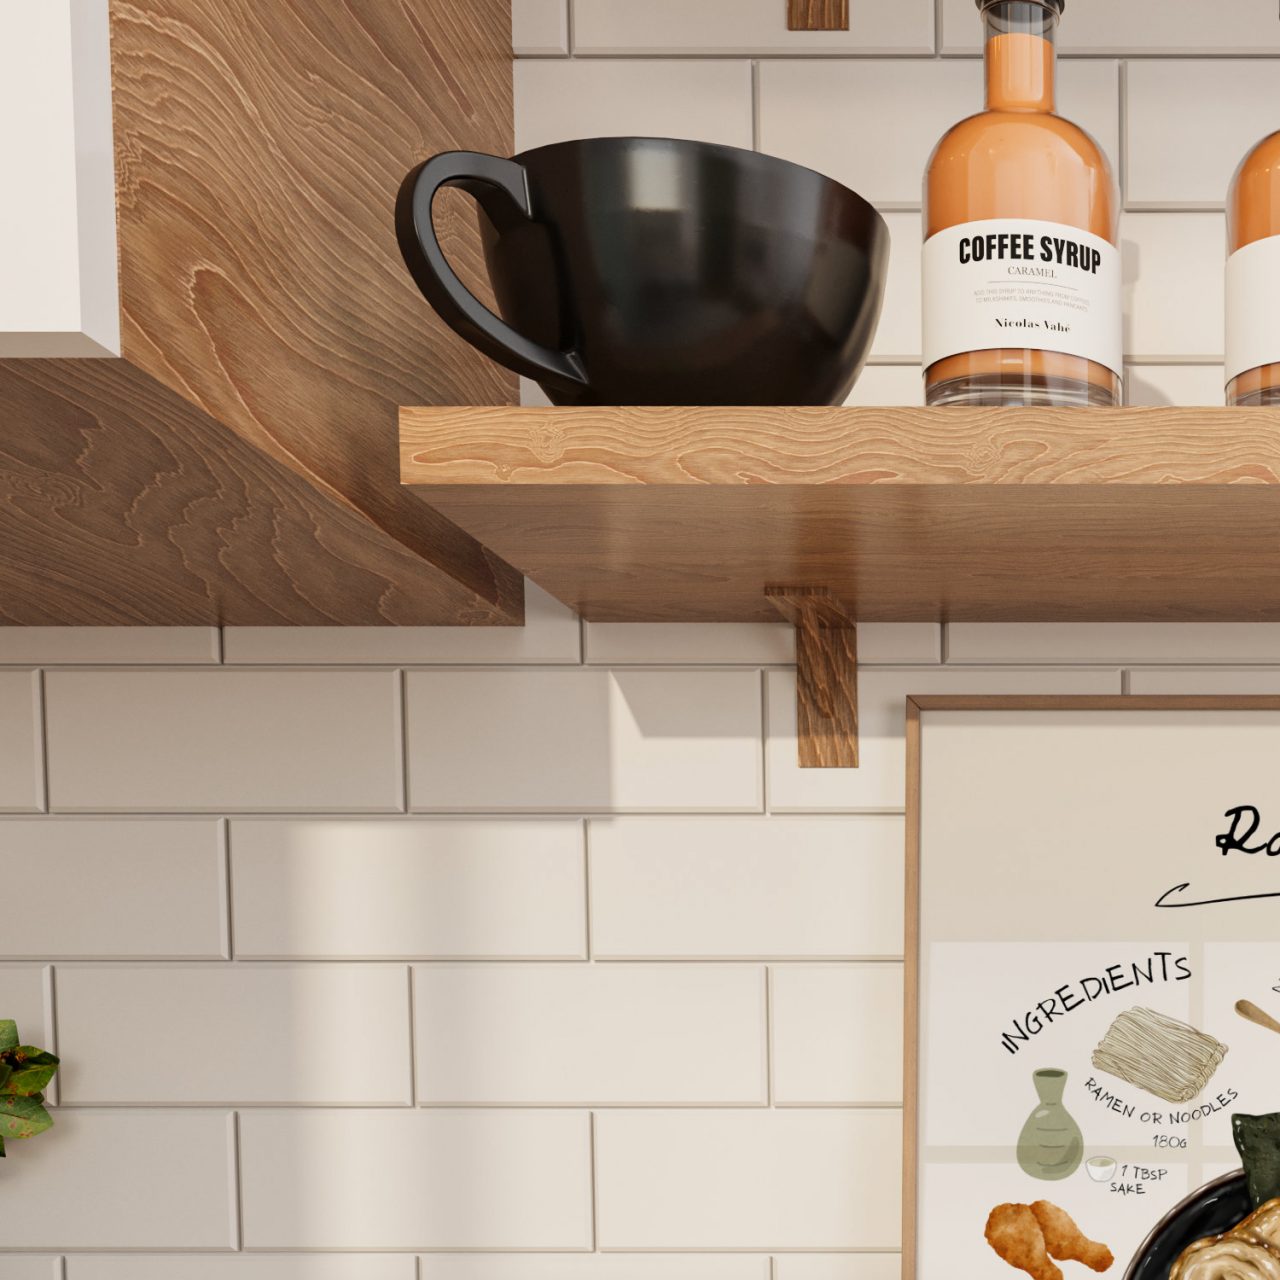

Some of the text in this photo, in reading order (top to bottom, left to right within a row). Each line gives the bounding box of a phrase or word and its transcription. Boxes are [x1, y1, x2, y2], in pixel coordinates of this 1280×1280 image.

[959, 233, 1101, 275] COFFEE SYRUP
[1007, 265, 1058, 280] CARAMEL
[994, 317, 1041, 329] Nicolas
[1000, 952, 1192, 1055] INGREDIENTS
[1084, 1076, 1239, 1125] RAMEN OR NOODLES
[1152, 1134, 1188, 1149] 180G
[1120, 1164, 1168, 1181] 1 TBSP
[1110, 1181, 1146, 1195] SAKE
